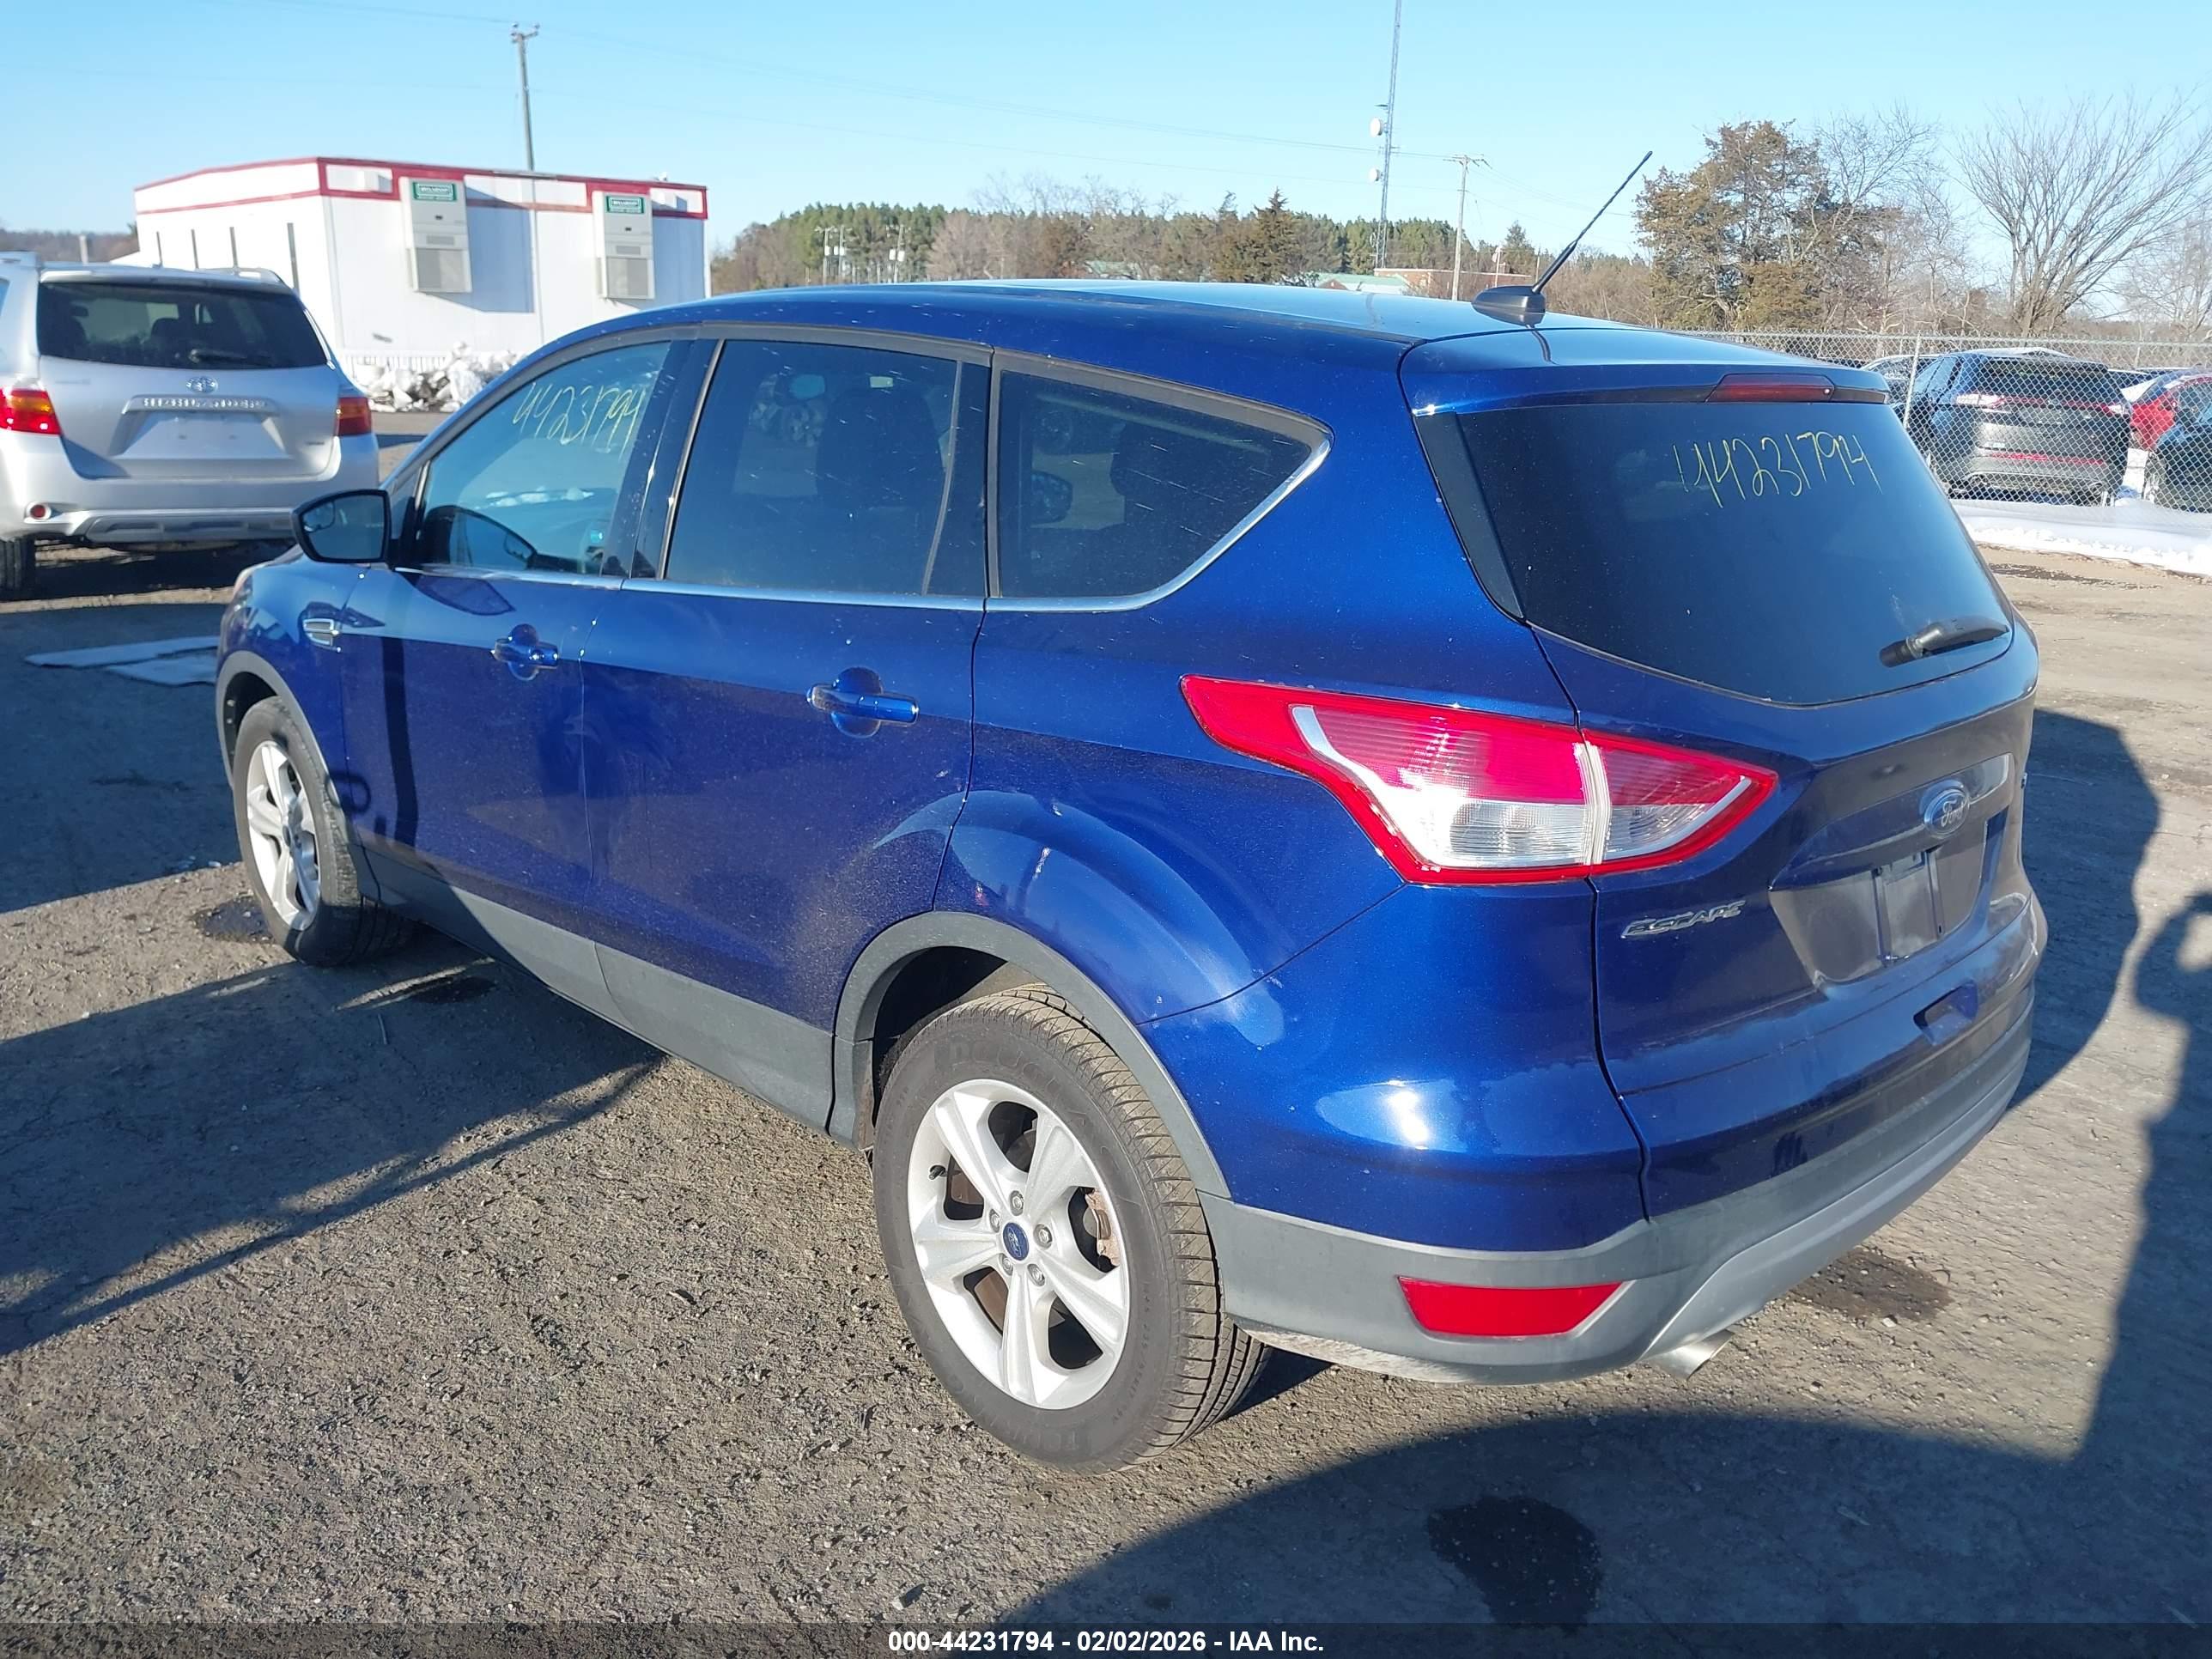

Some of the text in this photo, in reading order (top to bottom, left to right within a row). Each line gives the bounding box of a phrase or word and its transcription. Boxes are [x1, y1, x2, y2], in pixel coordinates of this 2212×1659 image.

[513, 382, 646, 463] 44231794
[1673, 431, 1884, 508] 44231794
[1620, 899, 1746, 939] ESCAPE
